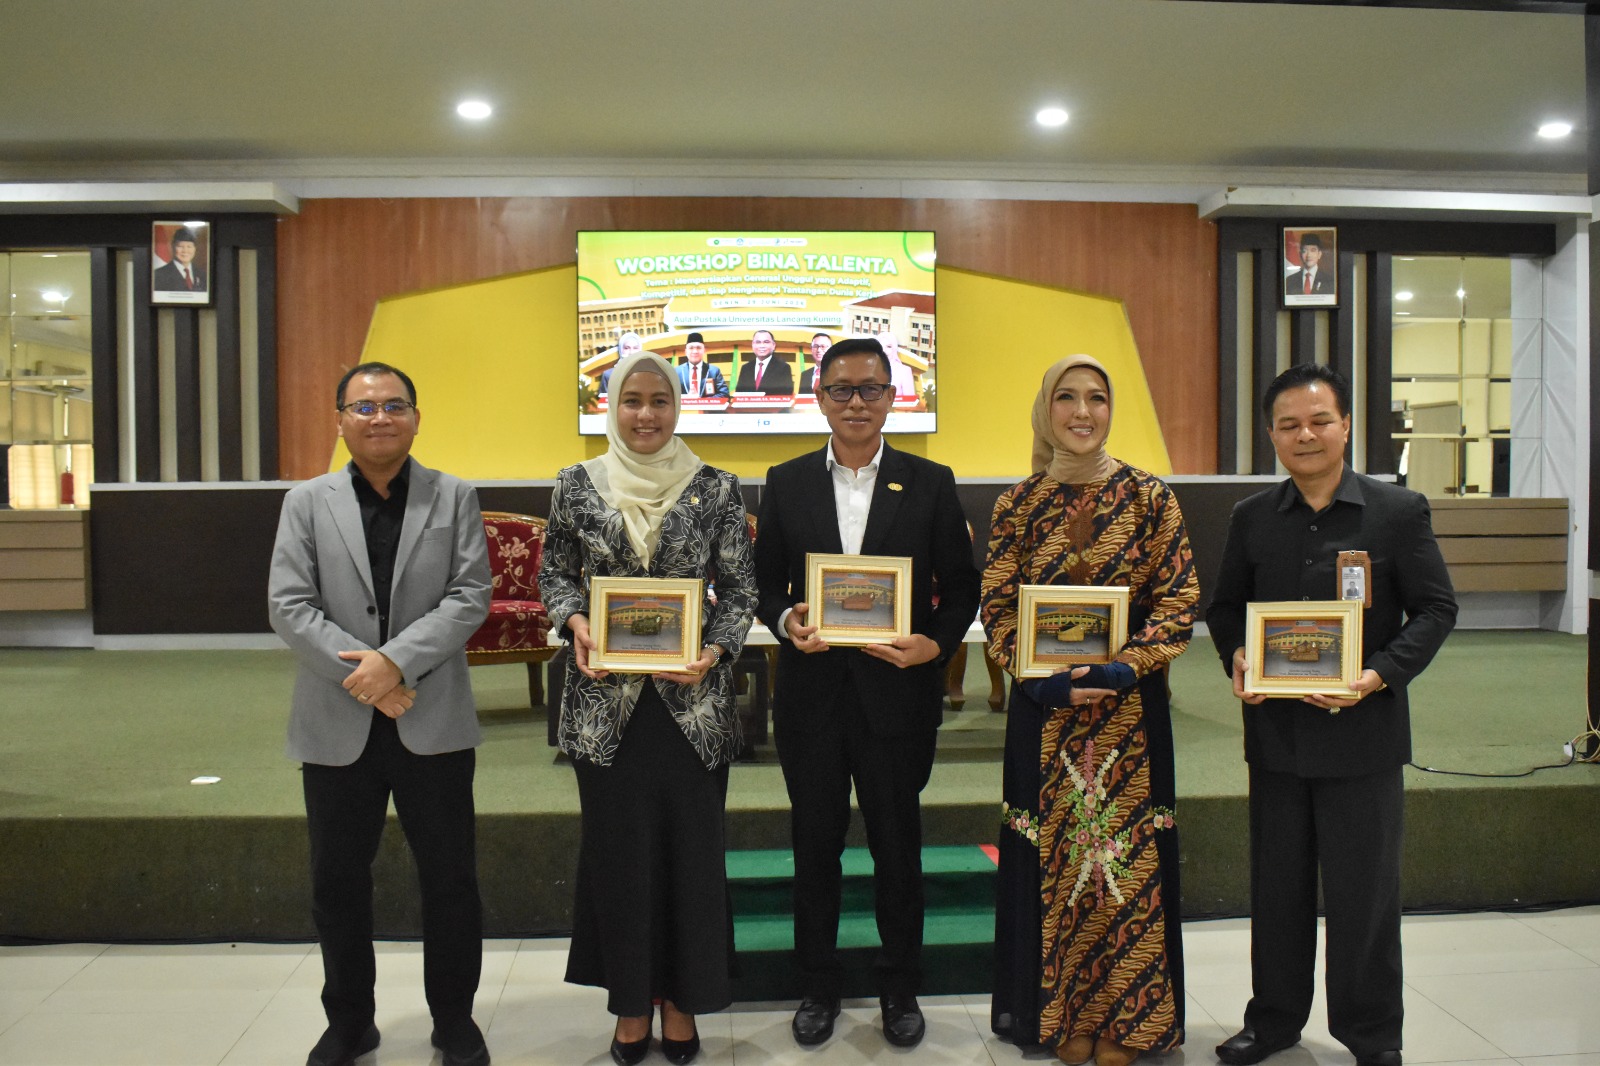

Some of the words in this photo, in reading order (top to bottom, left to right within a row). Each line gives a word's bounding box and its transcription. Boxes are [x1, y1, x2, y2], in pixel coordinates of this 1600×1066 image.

[616, 253, 742, 275] WORKSHOP
[747, 253, 800, 270] BINA
[804, 254, 898, 275] TALENTA
[645, 279, 669, 287] Tema
[674, 275, 743, 286] Mempersiapkan
[744, 274, 780, 283] Generasi
[782, 275, 813, 284] Unggul
[814, 277, 836, 286] yang
[837, 278, 871, 287] Adaptif,
[690, 288, 706, 296] dan
[707, 287, 727, 296] Siap
[728, 285, 780, 295] Menghadapi
[782, 286, 827, 296] Tantangan
[829, 288, 854, 296] Dunia
[777, 316, 811, 324] Lancang
[813, 316, 842, 324] Kuning
